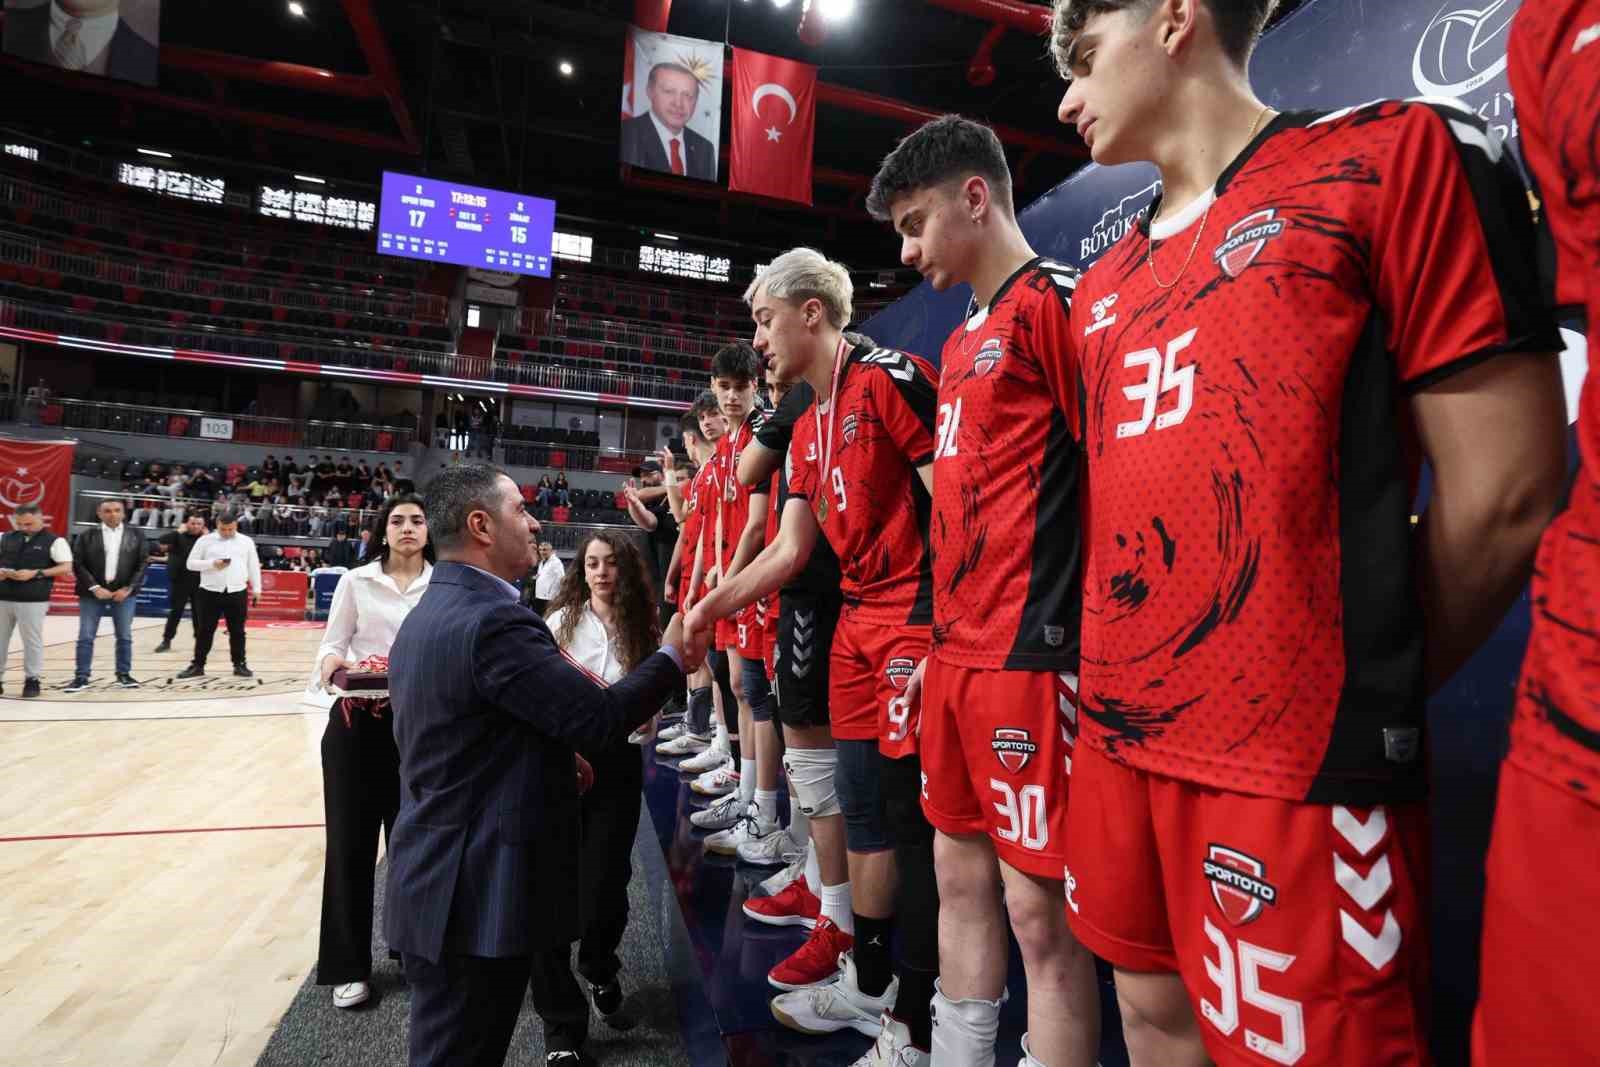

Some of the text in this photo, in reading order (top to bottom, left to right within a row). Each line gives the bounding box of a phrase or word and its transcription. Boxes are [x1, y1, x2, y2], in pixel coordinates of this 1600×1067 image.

[408, 209, 426, 228] 17
[510, 226, 527, 244] 15
[1214, 222, 1282, 260] SPORTOTO
[1116, 328, 1199, 439] 35
[206, 423, 229, 434] 103
[832, 466, 847, 513] 9
[886, 666, 914, 676] SPORTOT
[888, 696, 910, 741] 9
[992, 741, 1036, 752] SPORTOTO
[990, 777, 1049, 851] 30
[1203, 861, 1275, 901] SPORTOTO
[1200, 915, 1307, 1066] 35
